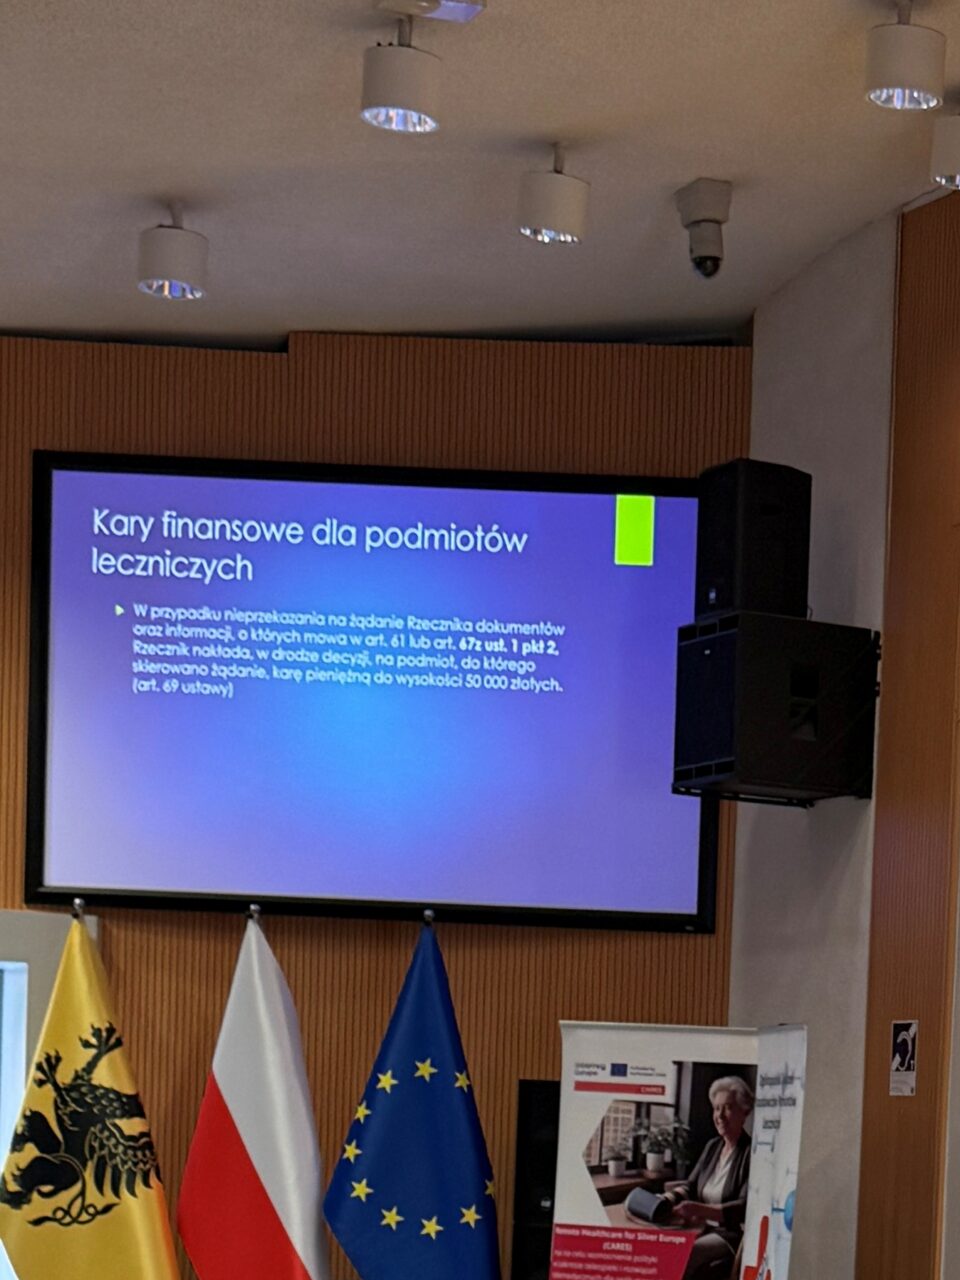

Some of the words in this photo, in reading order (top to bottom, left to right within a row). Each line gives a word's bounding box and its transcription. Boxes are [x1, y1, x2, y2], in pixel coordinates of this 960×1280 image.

[92, 507, 154, 543] Kary
[161, 510, 305, 544] finansowe
[311, 517, 357, 547] dla
[364, 521, 529, 553] podmiotów
[91, 546, 254, 585] leczniczych
[132, 603, 148, 618] W
[149, 606, 222, 622] przypadku
[223, 607, 326, 626] nieprzekazania
[327, 615, 347, 627] na
[348, 613, 404, 630] żądanie
[406, 615, 474, 633] Rzecznika
[475, 619, 566, 636] dokumentów
[132, 625, 164, 638] oraz
[237, 629, 249, 642] o
[250, 627, 302, 645] których
[303, 632, 348, 646] mowa
[349, 634, 363, 646] w
[364, 634, 388, 648] art.
[390, 634, 405, 648] 61
[408, 633, 432, 650] lub
[433, 637, 457, 651] art.
[458, 636, 482, 652] 67z
[484, 639, 508, 653] ust.
[511, 638, 518, 653] 1
[521, 639, 545, 657] pkt
[132, 640, 191, 657] Rzecznik
[255, 648, 269, 661] w
[271, 647, 319, 663] drodze
[375, 653, 394, 666] na
[460, 655, 481, 670] do
[483, 656, 536, 676] którego
[132, 659, 209, 677] skierowano
[271, 665, 303, 684] karę
[304, 667, 371, 686] pieniężną
[372, 670, 393, 685] do
[394, 672, 463, 689] wysokości
[465, 673, 482, 688] 50
[483, 674, 508, 690] 000
[509, 677, 564, 694] złotych.
[132, 677, 160, 694] (art.
[162, 679, 179, 693] 69
[180, 681, 234, 698] ustawy)
